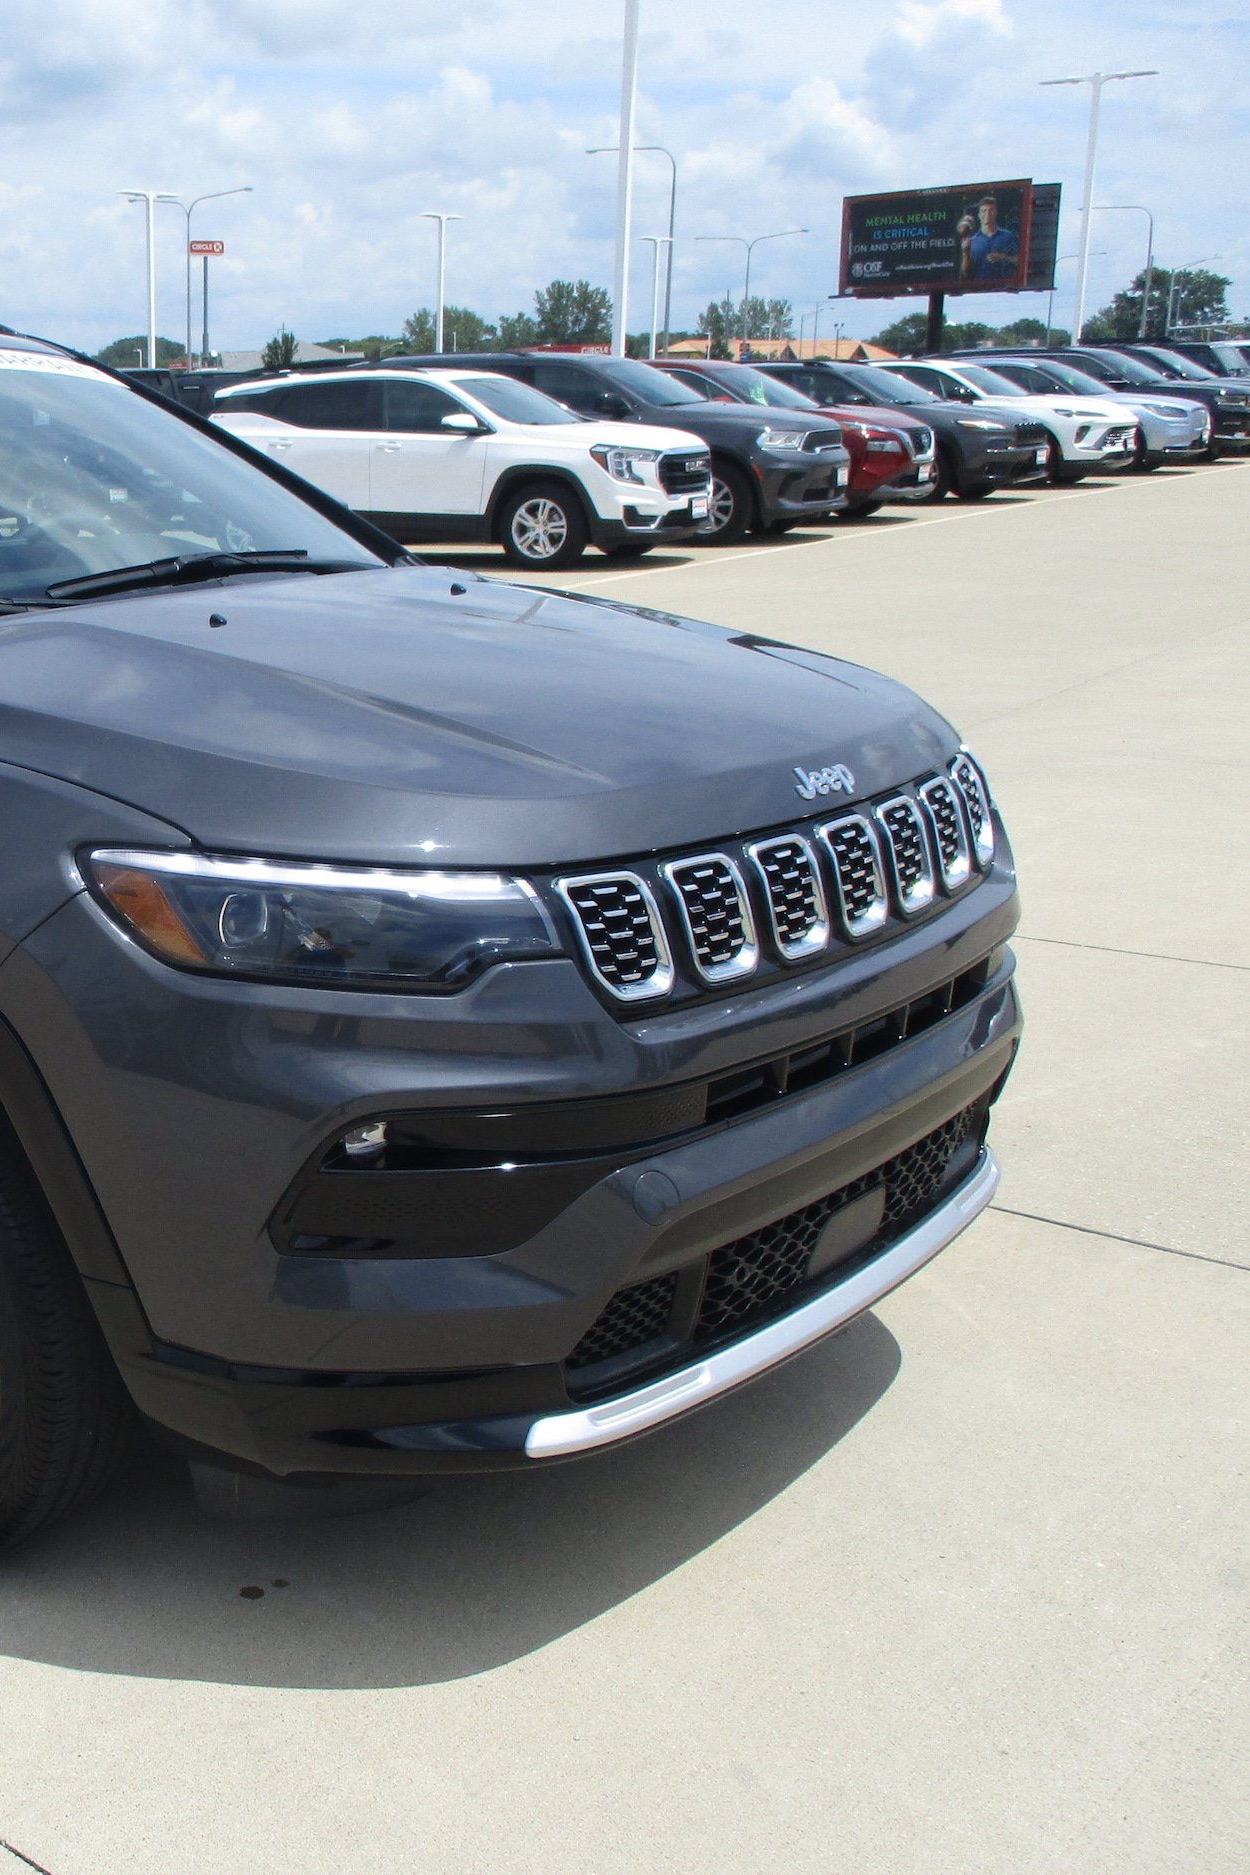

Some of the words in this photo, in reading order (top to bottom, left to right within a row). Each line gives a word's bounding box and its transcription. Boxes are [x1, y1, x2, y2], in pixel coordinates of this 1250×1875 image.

[865, 215, 905, 227] MENTAL
[907, 211, 947, 223] HEALTH
[873, 230, 882, 239] IS
[884, 227, 929, 239] CRITICAL
[853, 244, 868, 254] ON
[869, 243, 889, 252] AND
[890, 241, 908, 251] OFF
[910, 240, 927, 249] THE
[863, 261, 883, 273] OSF
[581, 346, 610, 354] CIRCLE
[793, 763, 855, 800] Jeep
